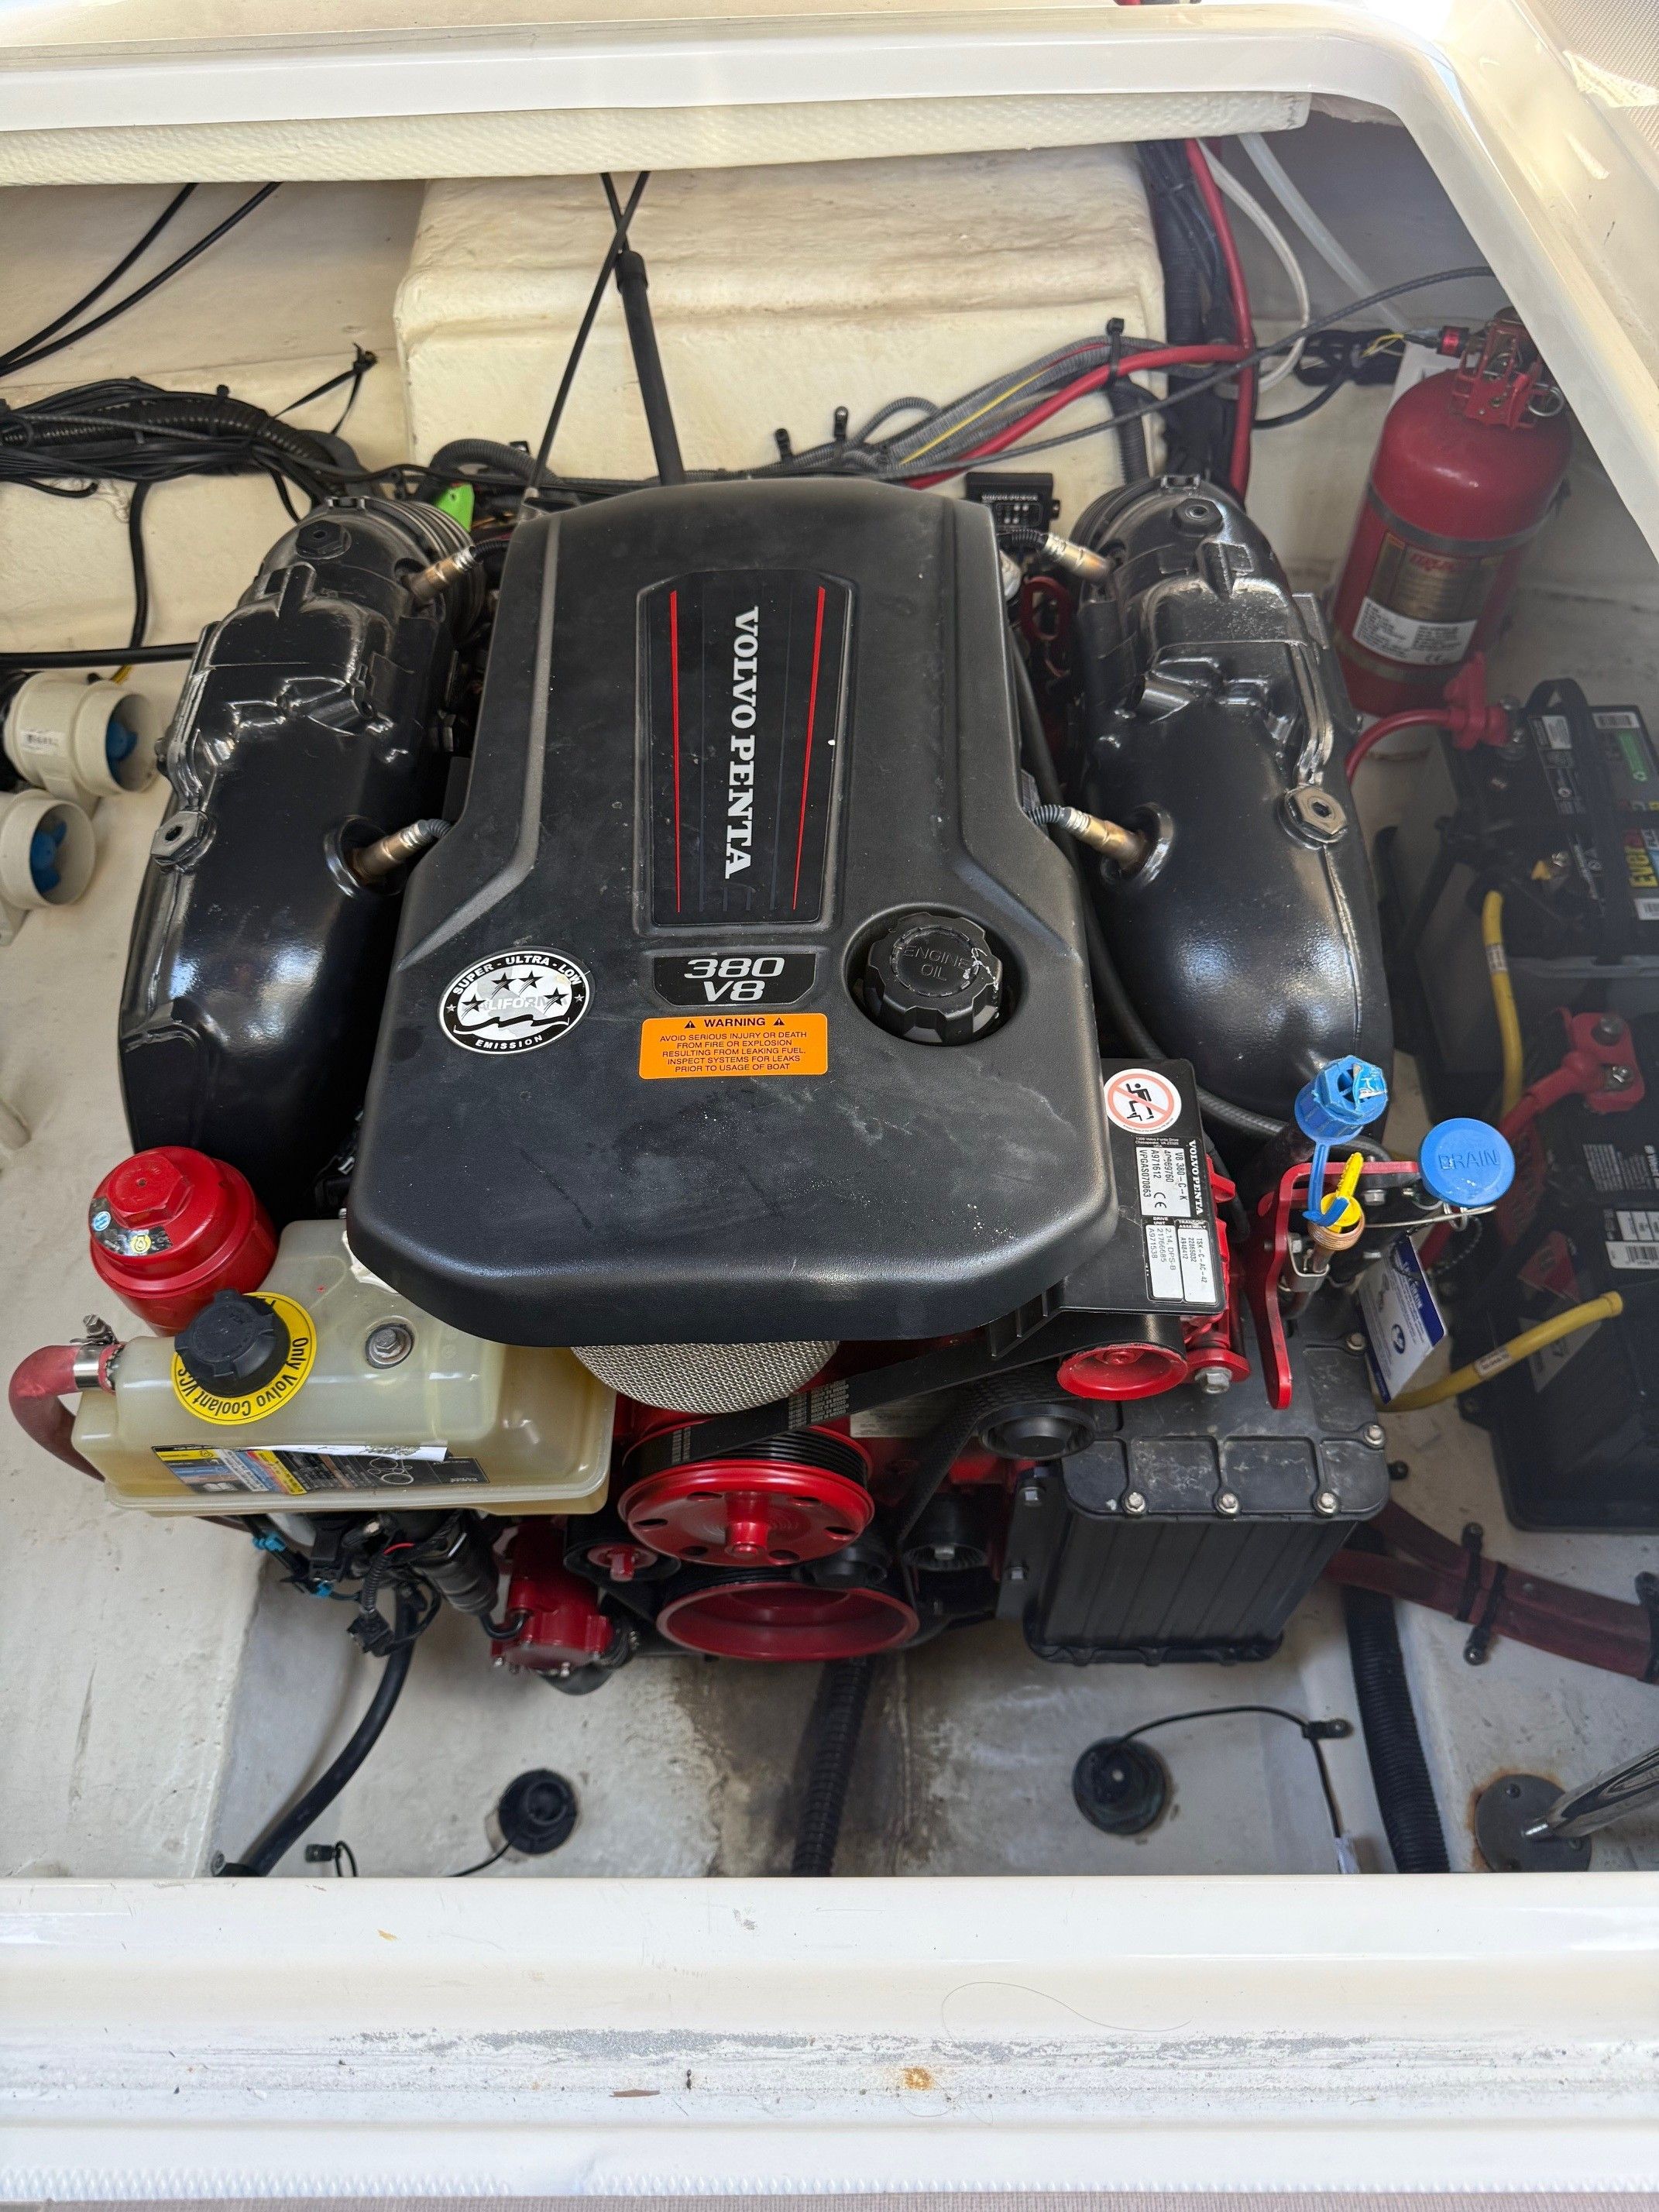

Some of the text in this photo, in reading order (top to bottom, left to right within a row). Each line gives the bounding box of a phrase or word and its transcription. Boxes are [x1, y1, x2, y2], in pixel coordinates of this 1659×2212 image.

[725, 605, 760, 879] VOLVO PENTA
[684, 957, 785, 979] 380
[903, 946, 971, 970] ENGINE
[453, 963, 494, 995] SUPER
[505, 955, 550, 966] ULTRA
[558, 963, 582, 985] LOW
[921, 963, 946, 981] OIL
[703, 980, 765, 1002] V8
[704, 1018, 766, 1028] WARNING
[475, 1035, 543, 1049] EMISSION
[662, 1049, 711, 1058] RESULTING
[1150, 1149, 1162, 1179] A971612
[1175, 1152, 1183, 1161] V8
[1438, 1149, 1500, 1171] DRAIN
[1139, 1149, 1151, 1197] VPGAS070863
[1188, 1139, 1204, 1215] VOLVO PENTA
[287, 1337, 309, 1370] Only
[256, 1375, 298, 1407] Volvo
[193, 1390, 252, 1417] Coolant
